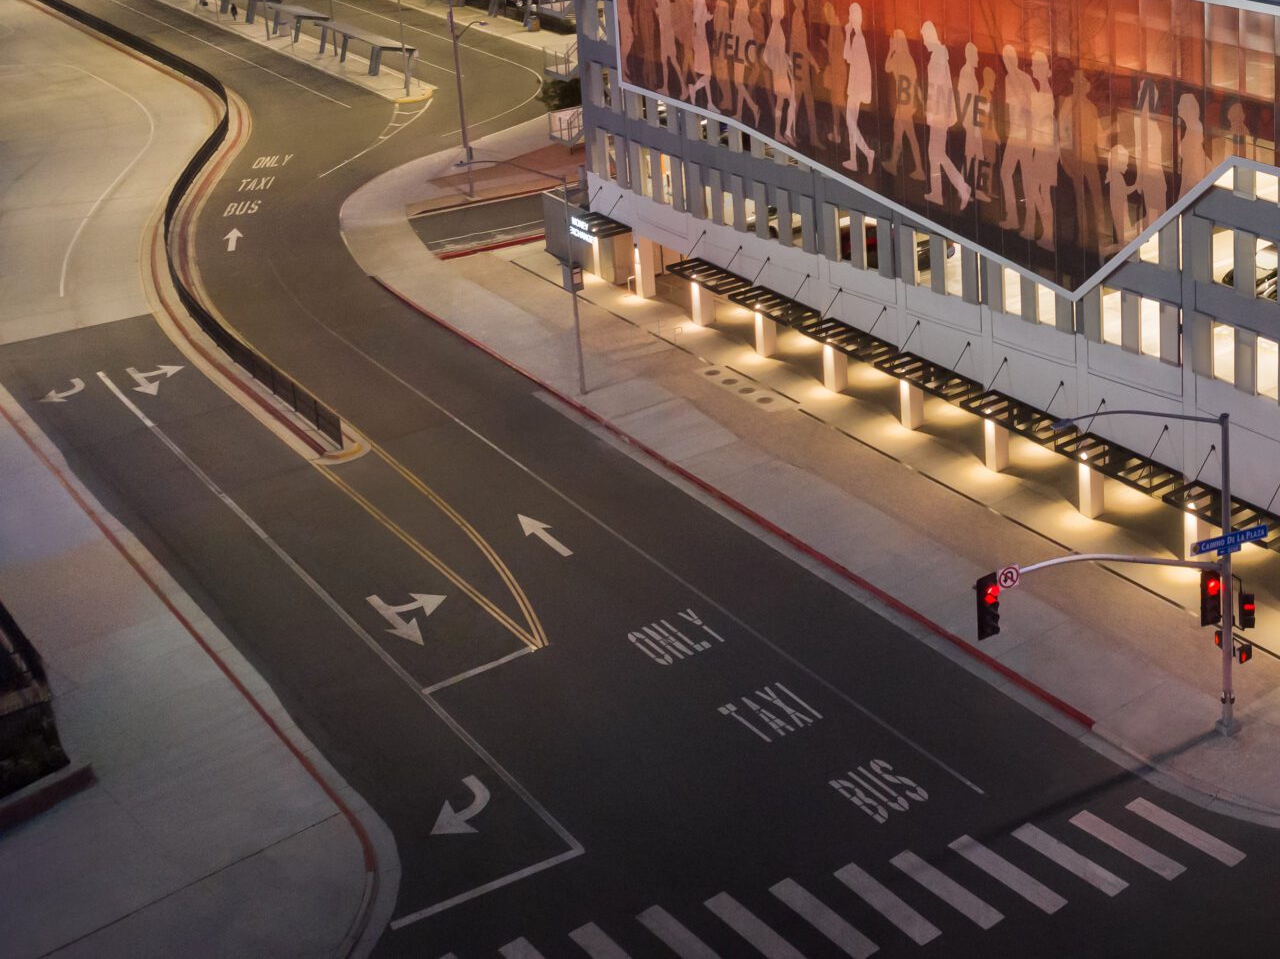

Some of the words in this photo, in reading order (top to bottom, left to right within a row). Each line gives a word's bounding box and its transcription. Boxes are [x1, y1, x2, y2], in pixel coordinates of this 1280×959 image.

[252, 153, 294, 170] ONLY
[237, 176, 275, 193] TAXI
[223, 199, 262, 218] BUS
[1237, 533, 1246, 542] LA
[1246, 528, 1265, 540] PLAZA
[627, 608, 725, 666] ONLY
[717, 682, 824, 743] TAXI
[828, 759, 929, 824] BUS
